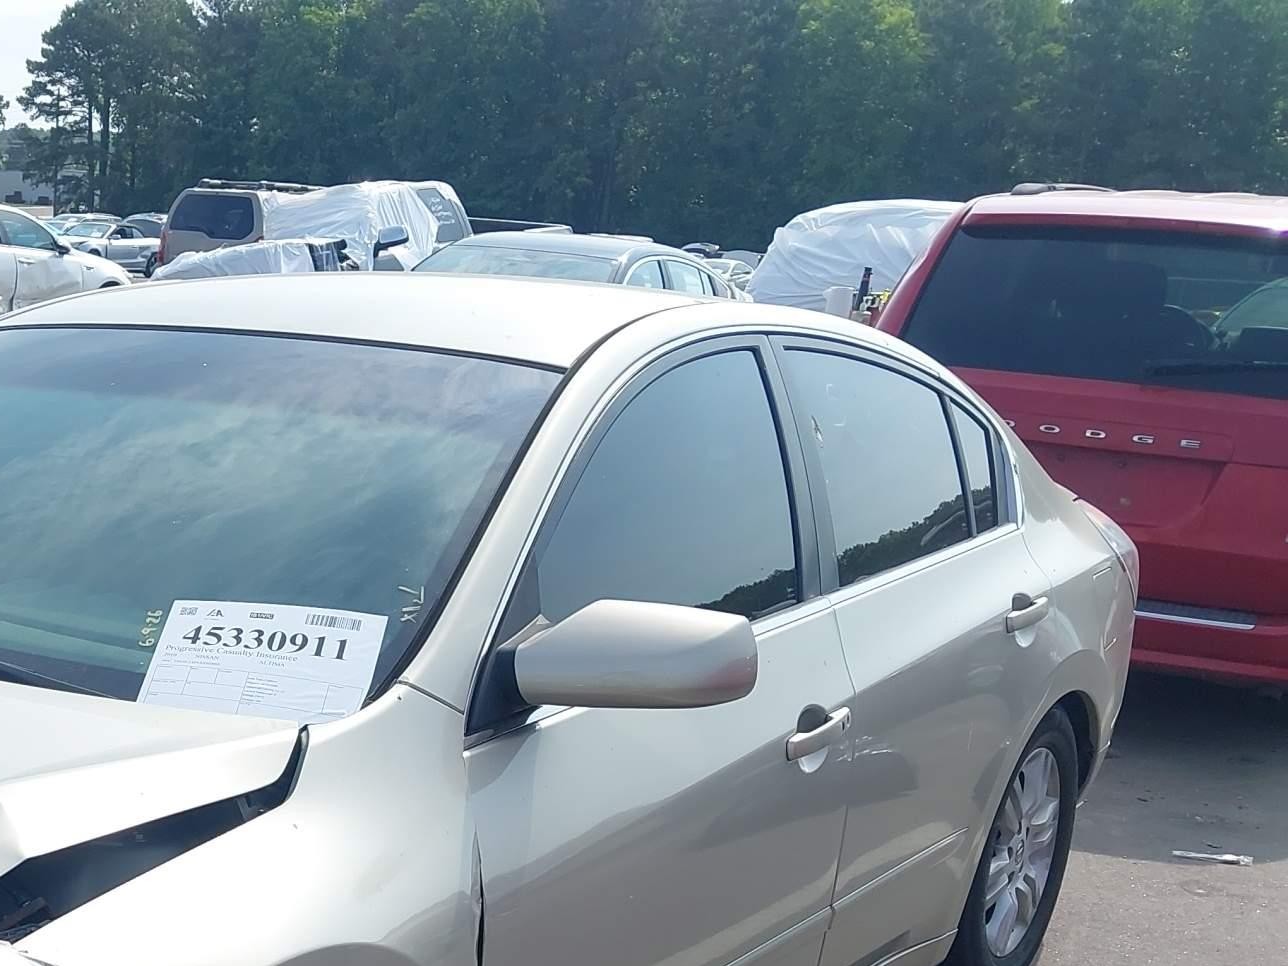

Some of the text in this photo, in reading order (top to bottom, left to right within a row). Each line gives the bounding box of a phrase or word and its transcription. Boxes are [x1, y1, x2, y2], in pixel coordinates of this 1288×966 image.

[165, 643, 298, 662] Progressive Casualty Insurance
[182, 625, 349, 661] 45330911
